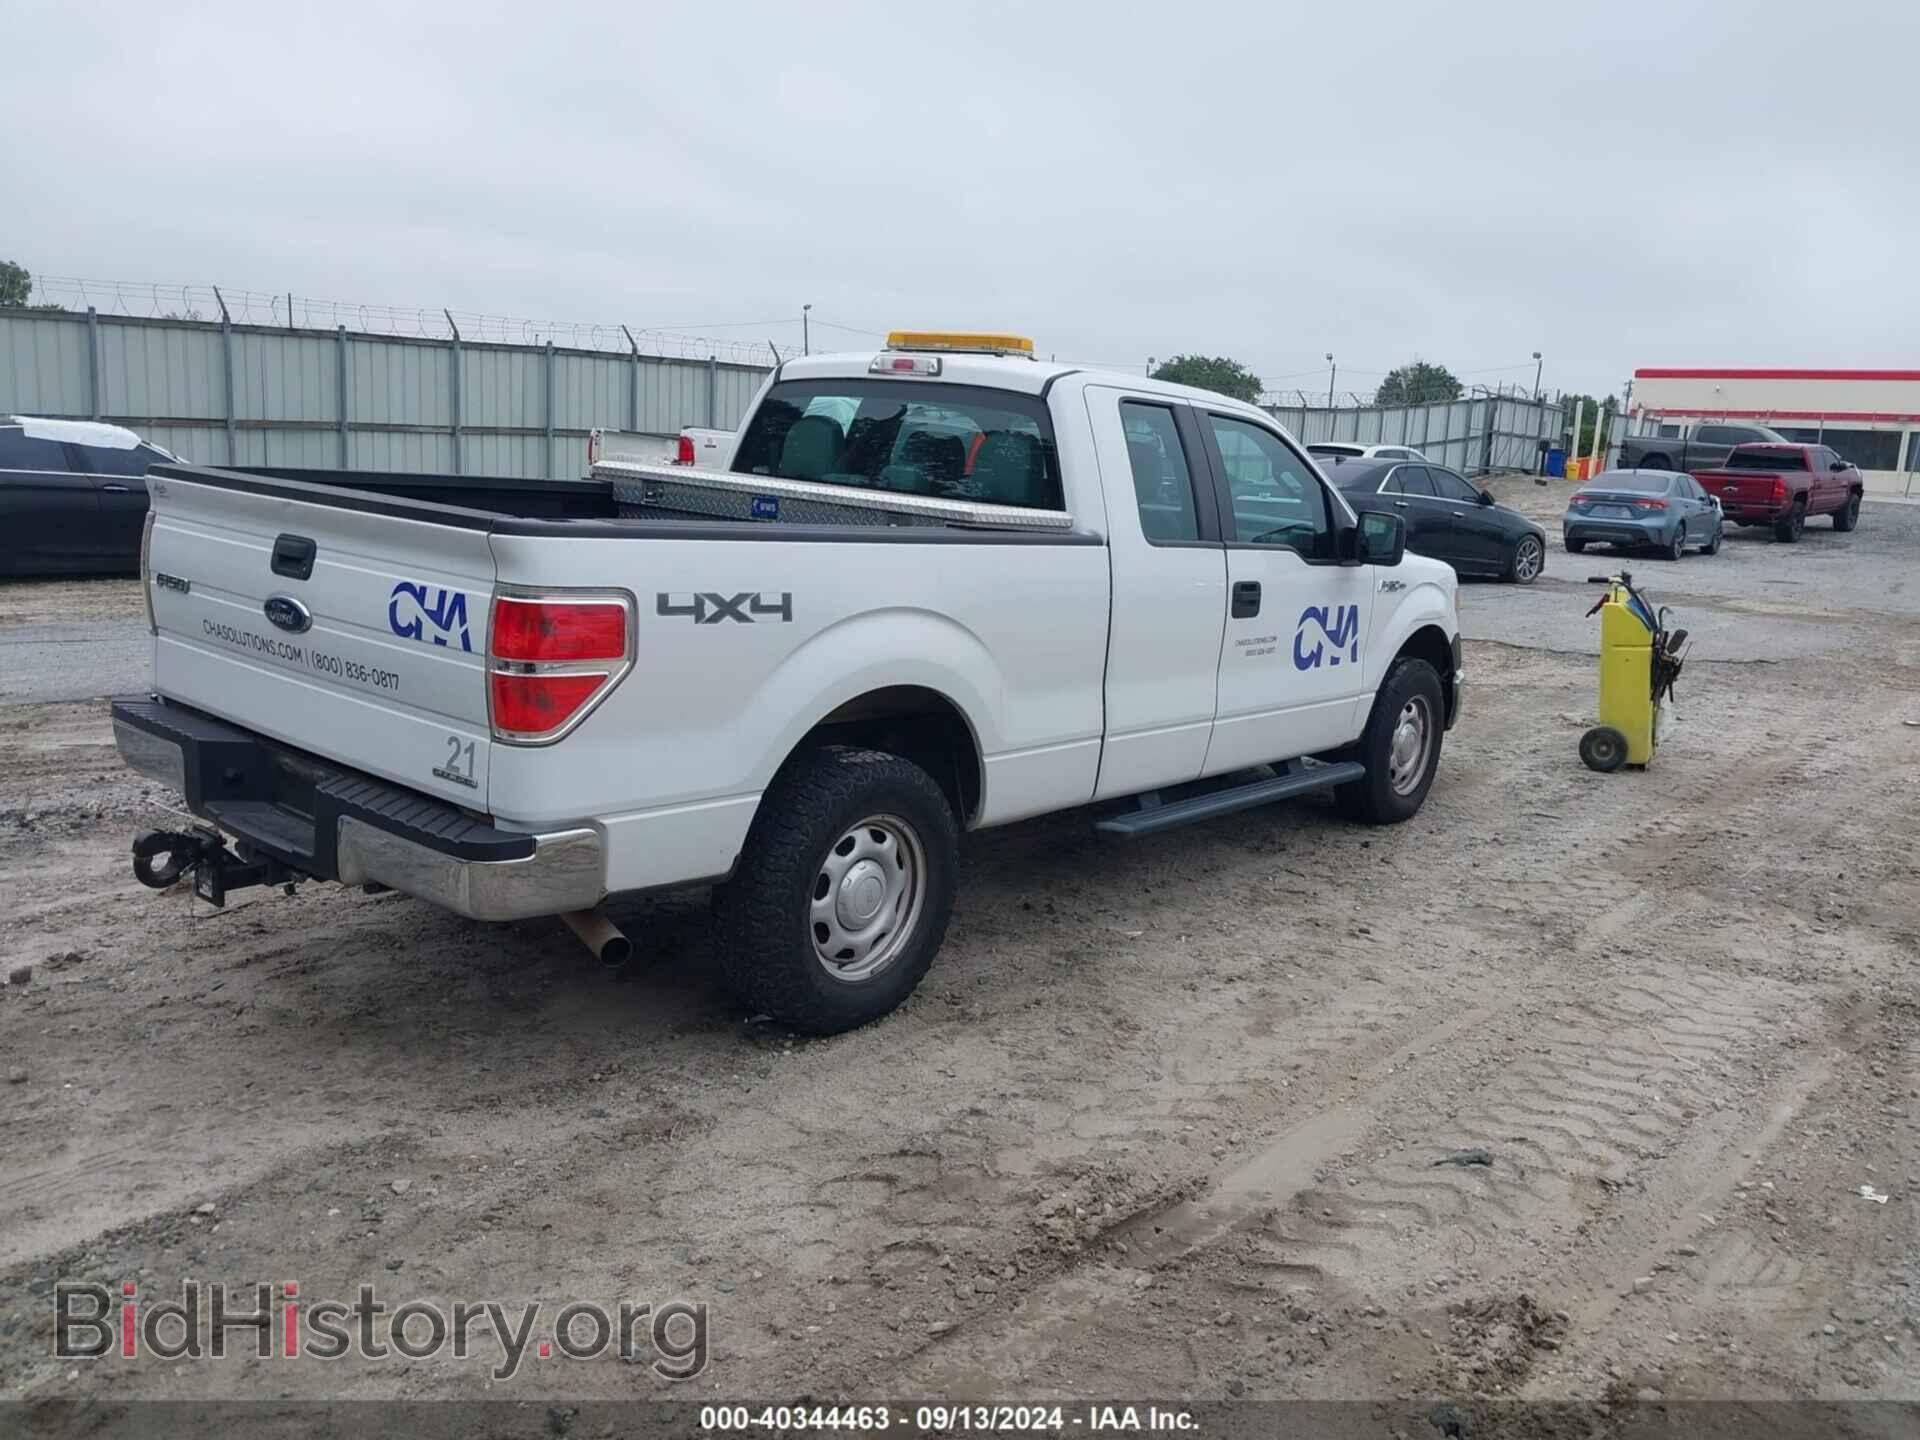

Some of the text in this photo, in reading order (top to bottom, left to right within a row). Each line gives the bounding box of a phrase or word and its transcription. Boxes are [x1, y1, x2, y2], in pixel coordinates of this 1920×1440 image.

[388, 581, 473, 653] CHA
[1293, 604, 1358, 671] CHA
[202, 619, 302, 662] CHASOLUTIONS.COM
[311, 650, 343, 677] (800)
[345, 660, 400, 690] 836-0817
[446, 735, 475, 779] 21
